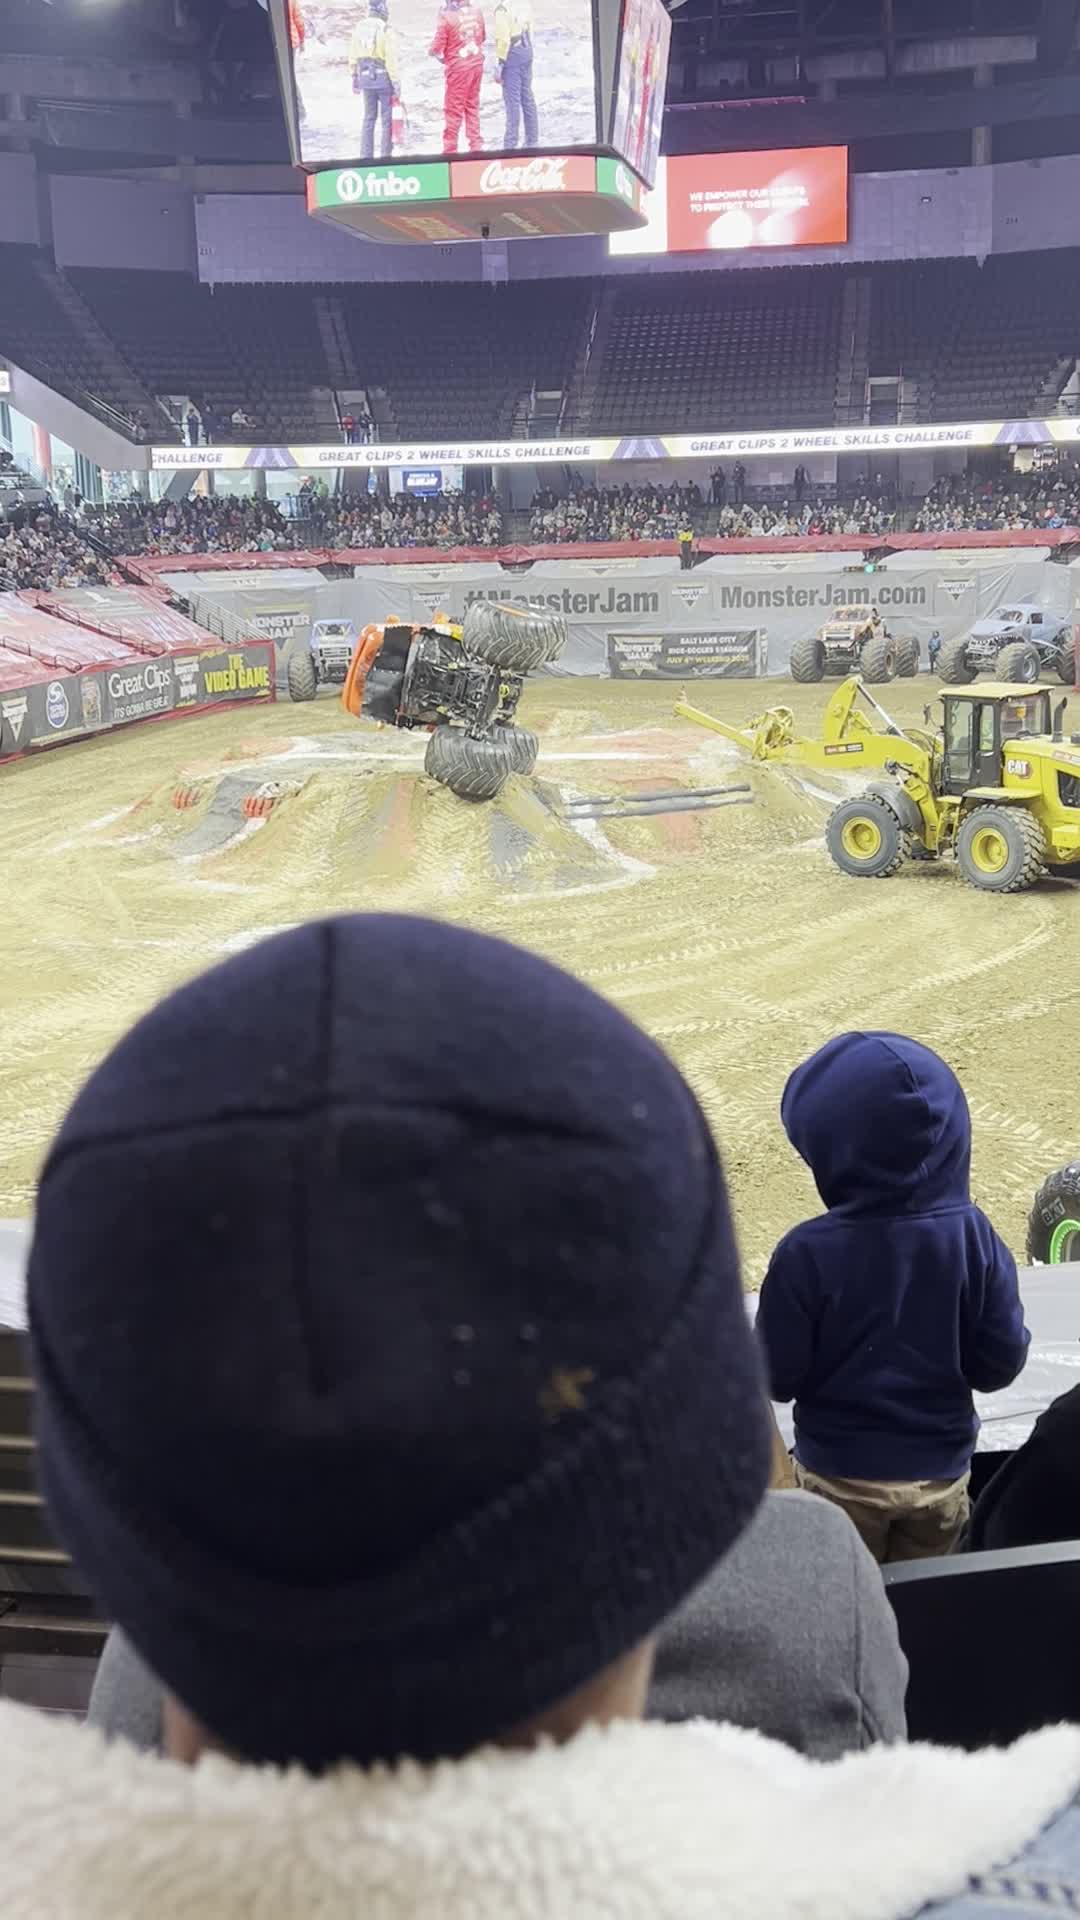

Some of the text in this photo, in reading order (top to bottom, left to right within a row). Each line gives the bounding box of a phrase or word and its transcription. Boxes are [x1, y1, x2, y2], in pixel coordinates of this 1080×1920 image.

[365, 170, 421, 197] fnbo
[480, 158, 569, 194] Coca-Cola
[318, 445, 591, 462] GREAT CLIPS 2 WHEEL SKILLS CHALLENGE
[691, 430, 973, 451] GREAT CLIPS 2 WHEEL SKILLS CHALLENGE
[721, 583, 926, 609] MonsterJam.com
[680, 635, 737, 645] SALT LAKE CITY
[108, 673, 144, 698] Great
[144, 664, 171, 694] Clips
[205, 669, 236, 693] VIDEO
[238, 666, 271, 688] GAME
[1007, 759, 1028, 776] CAT
